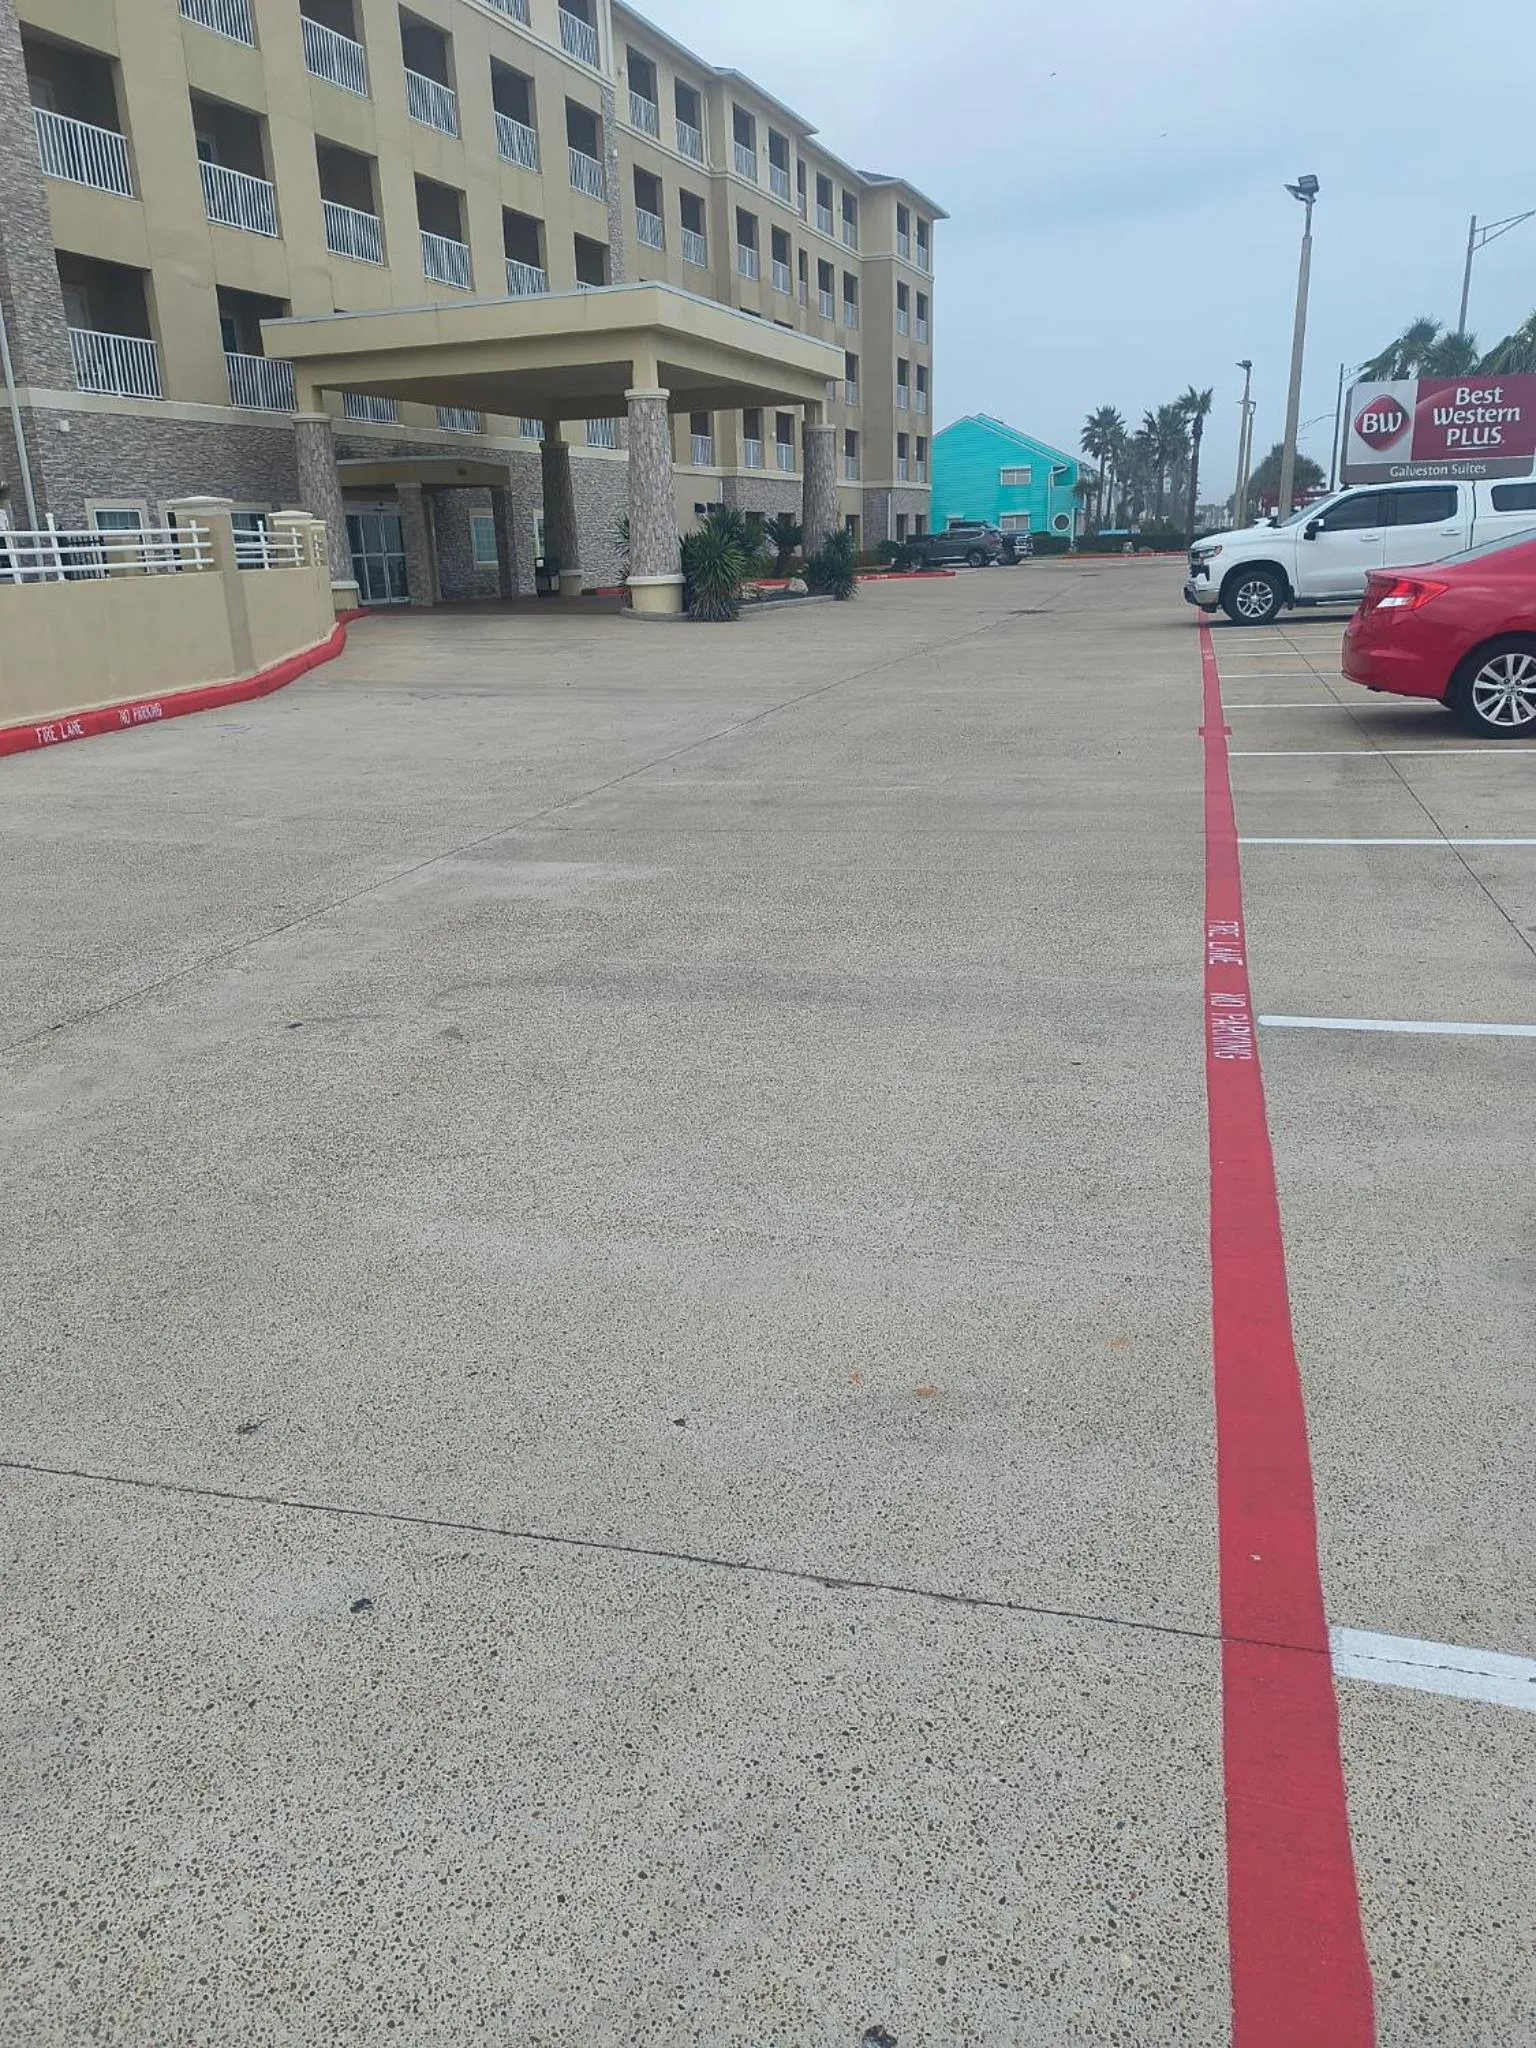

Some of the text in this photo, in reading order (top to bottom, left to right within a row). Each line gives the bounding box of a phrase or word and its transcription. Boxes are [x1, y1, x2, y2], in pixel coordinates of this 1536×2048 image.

[1456, 386, 1504, 405] Best
[1361, 412, 1402, 433] BW
[1433, 407, 1521, 425] Western
[1446, 426, 1503, 446] PLUS
[1389, 463, 1487, 478] Galveston Suites
[118, 703, 162, 725] NO PARKING
[35, 719, 84, 744] FIRE LANE
[1208, 920, 1243, 966] FIRE LANE
[1210, 993, 1252, 1060] NO PARKING
